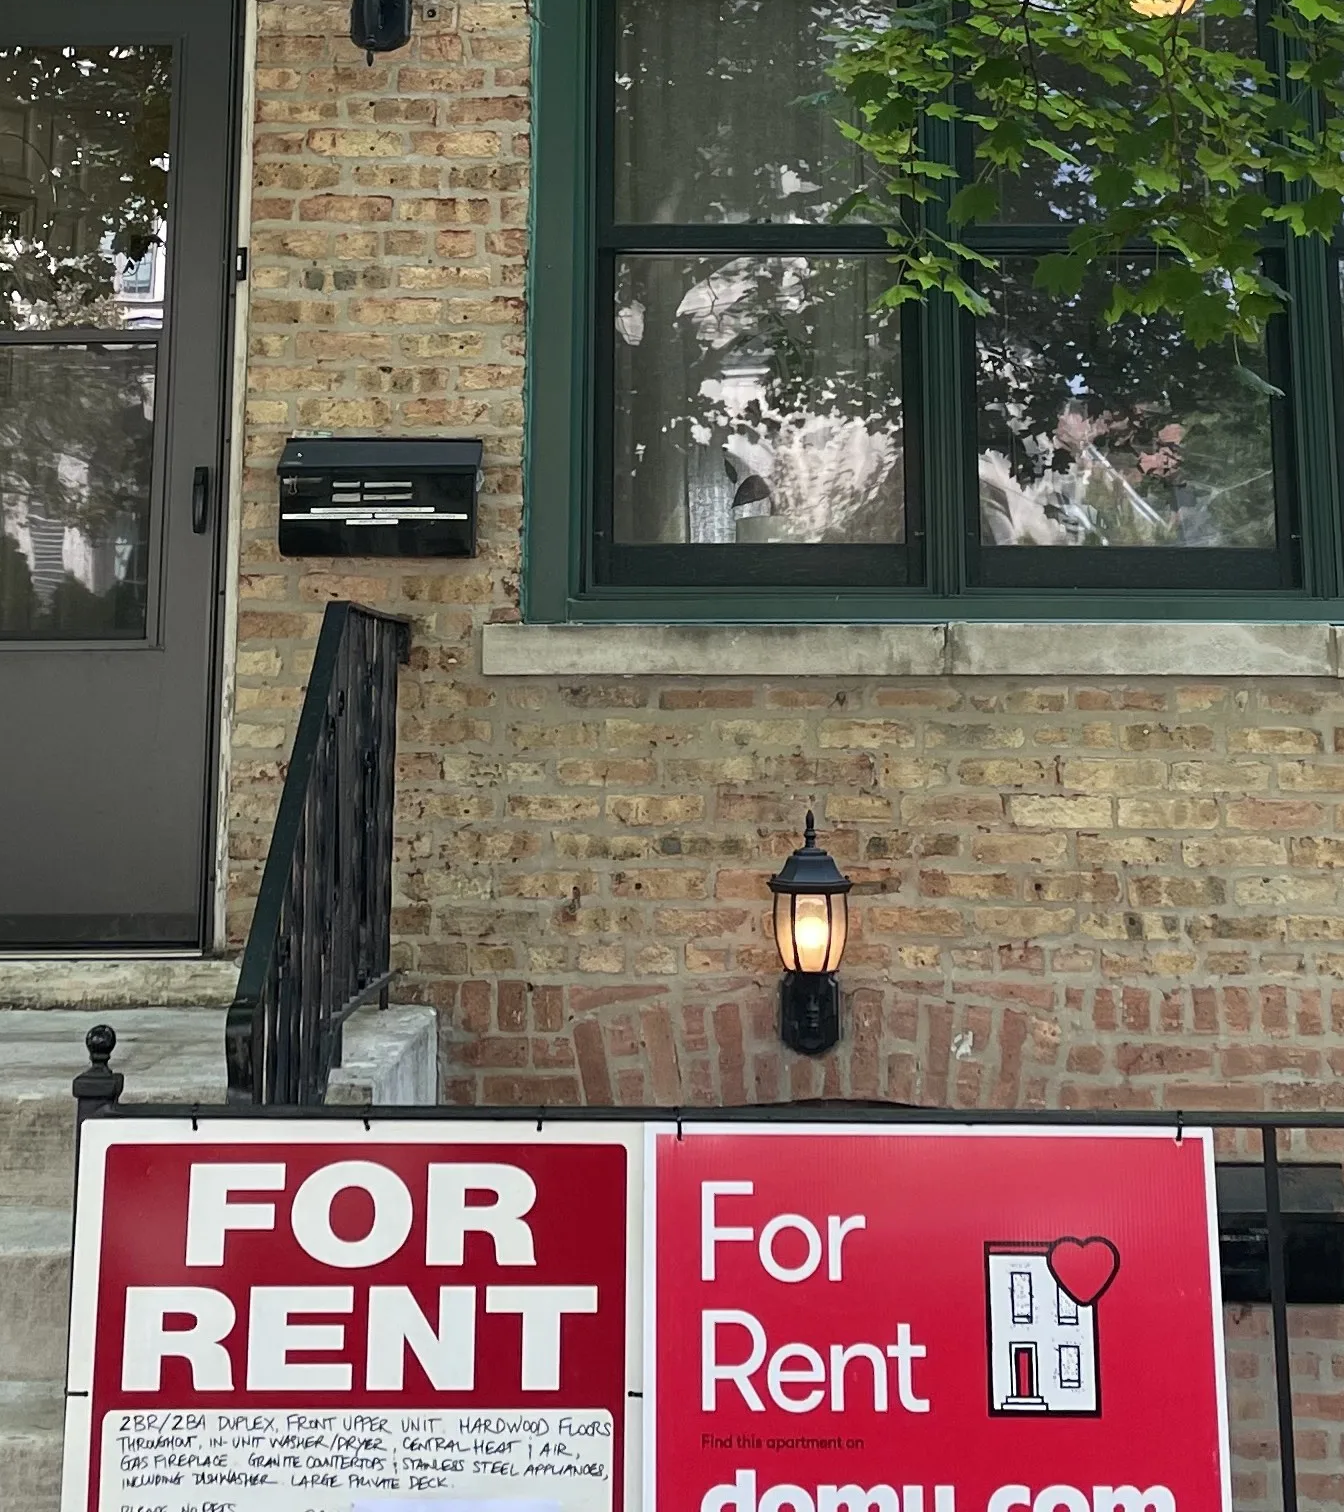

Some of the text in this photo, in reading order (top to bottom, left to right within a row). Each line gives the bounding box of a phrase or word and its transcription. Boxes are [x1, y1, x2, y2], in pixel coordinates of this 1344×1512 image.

[185, 1160, 537, 1268] FOR
[701, 1180, 866, 1283] For
[121, 1285, 598, 1392] RENT
[701, 1309, 931, 1413] Rent
[119, 1413, 206, 1434] 2BR/2BA
[218, 1415, 279, 1433] DUPLEX,
[287, 1413, 337, 1432] FRONT
[343, 1414, 393, 1434] UPPER
[459, 1414, 550, 1437] HARDWOOD
[558, 1416, 612, 1437] FLOORS
[701, 1433, 865, 1452] Find this apartment on
[402, 1436, 471, 1453] CENTRAL
[474, 1438, 522, 1456] HEAT
[120, 1454, 149, 1472] GAS
[248, 1452, 303, 1469] GRANITE
[472, 1460, 520, 1477] STEEL
[523, 1462, 609, 1482] APPLIANCES,
[290, 1472, 344, 1489] LARGE
[700, 1469, 1177, 1512] domucom
